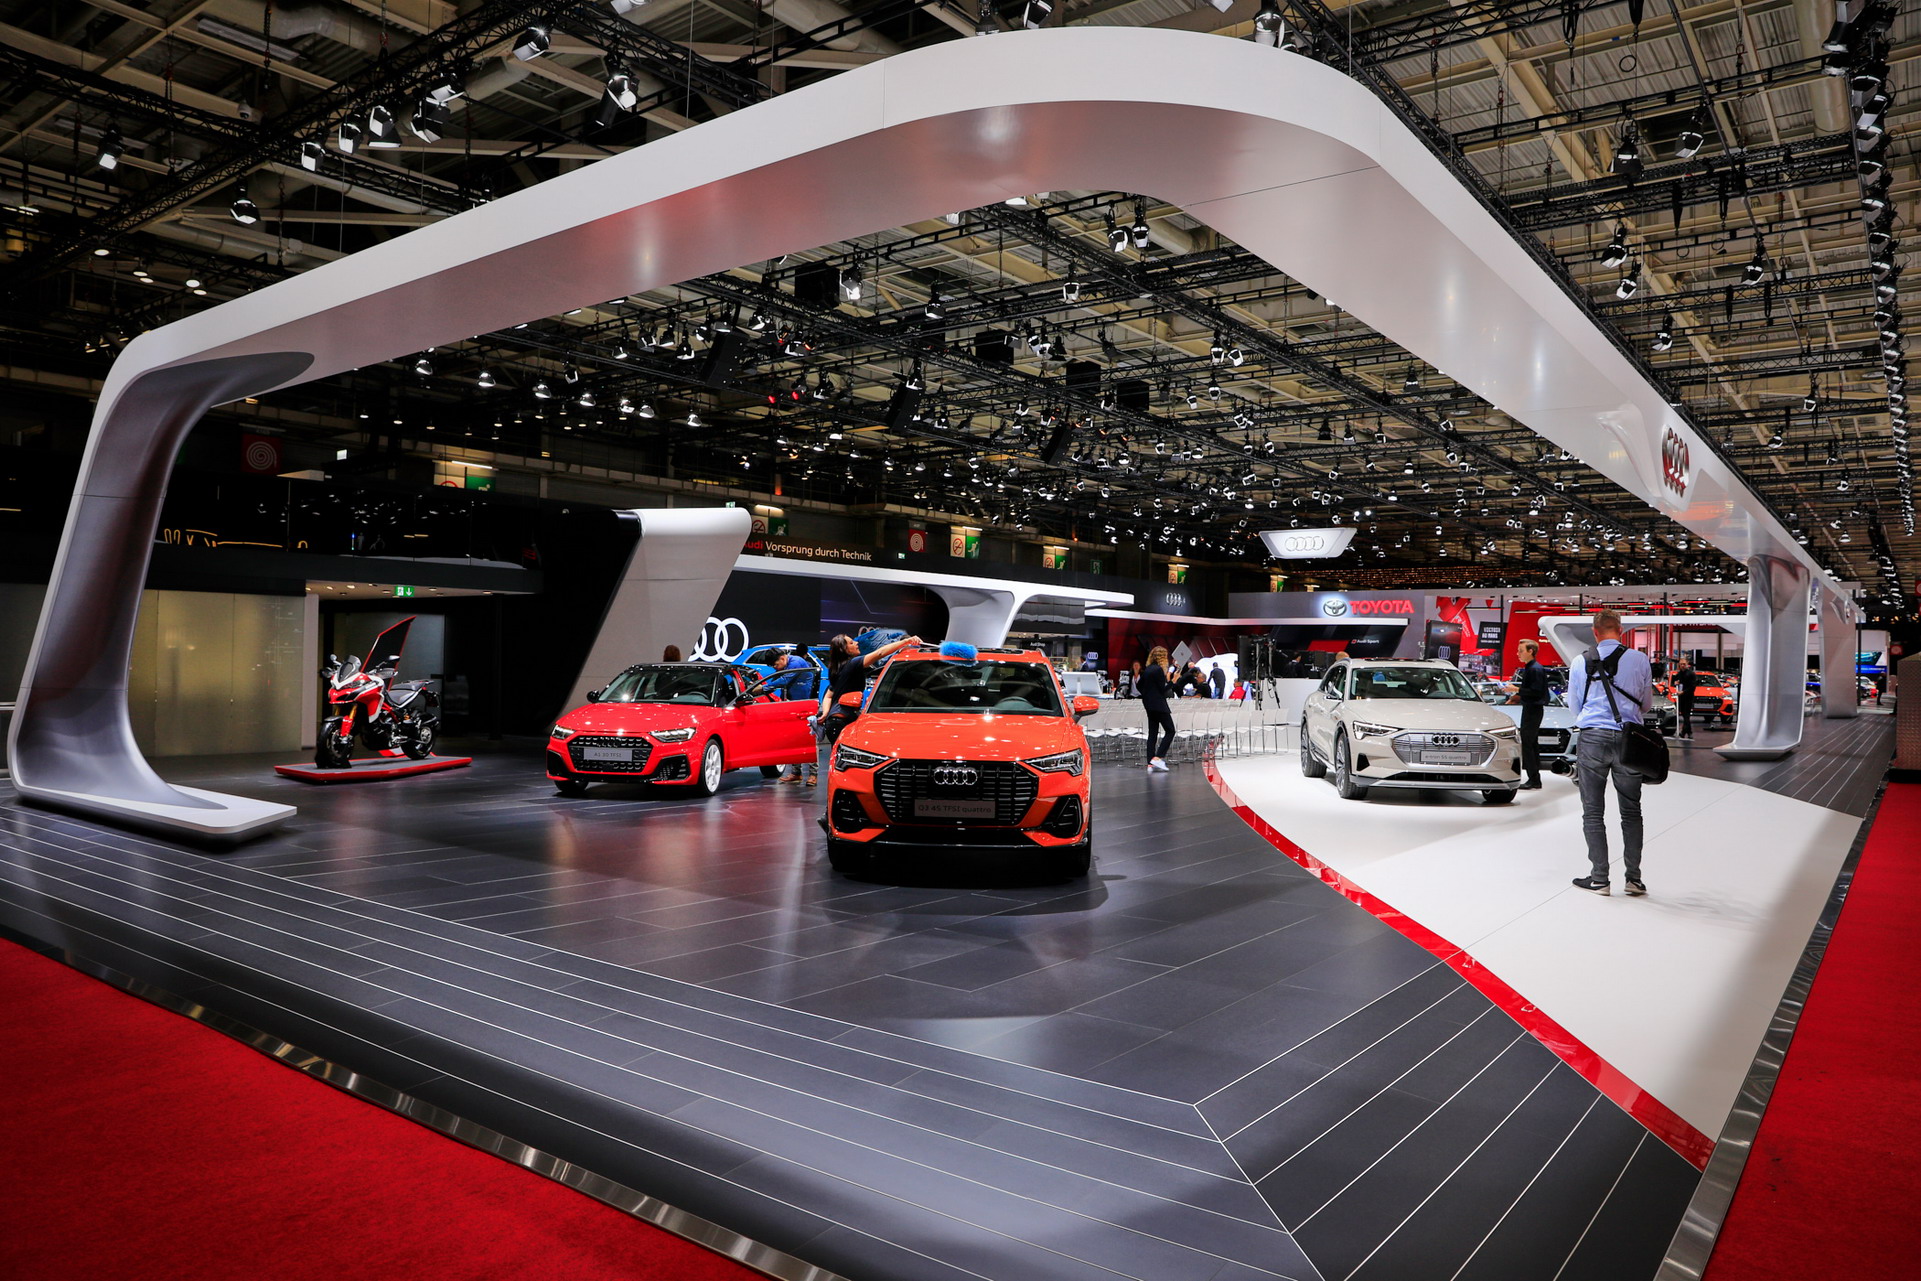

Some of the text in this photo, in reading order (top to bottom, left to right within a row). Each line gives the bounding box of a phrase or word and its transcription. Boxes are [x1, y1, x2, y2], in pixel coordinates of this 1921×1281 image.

[765, 541, 813, 557] Vorsprung
[815, 547, 840, 558] durch
[841, 549, 872, 561] Technik
[1349, 599, 1415, 615] TOYOTA
